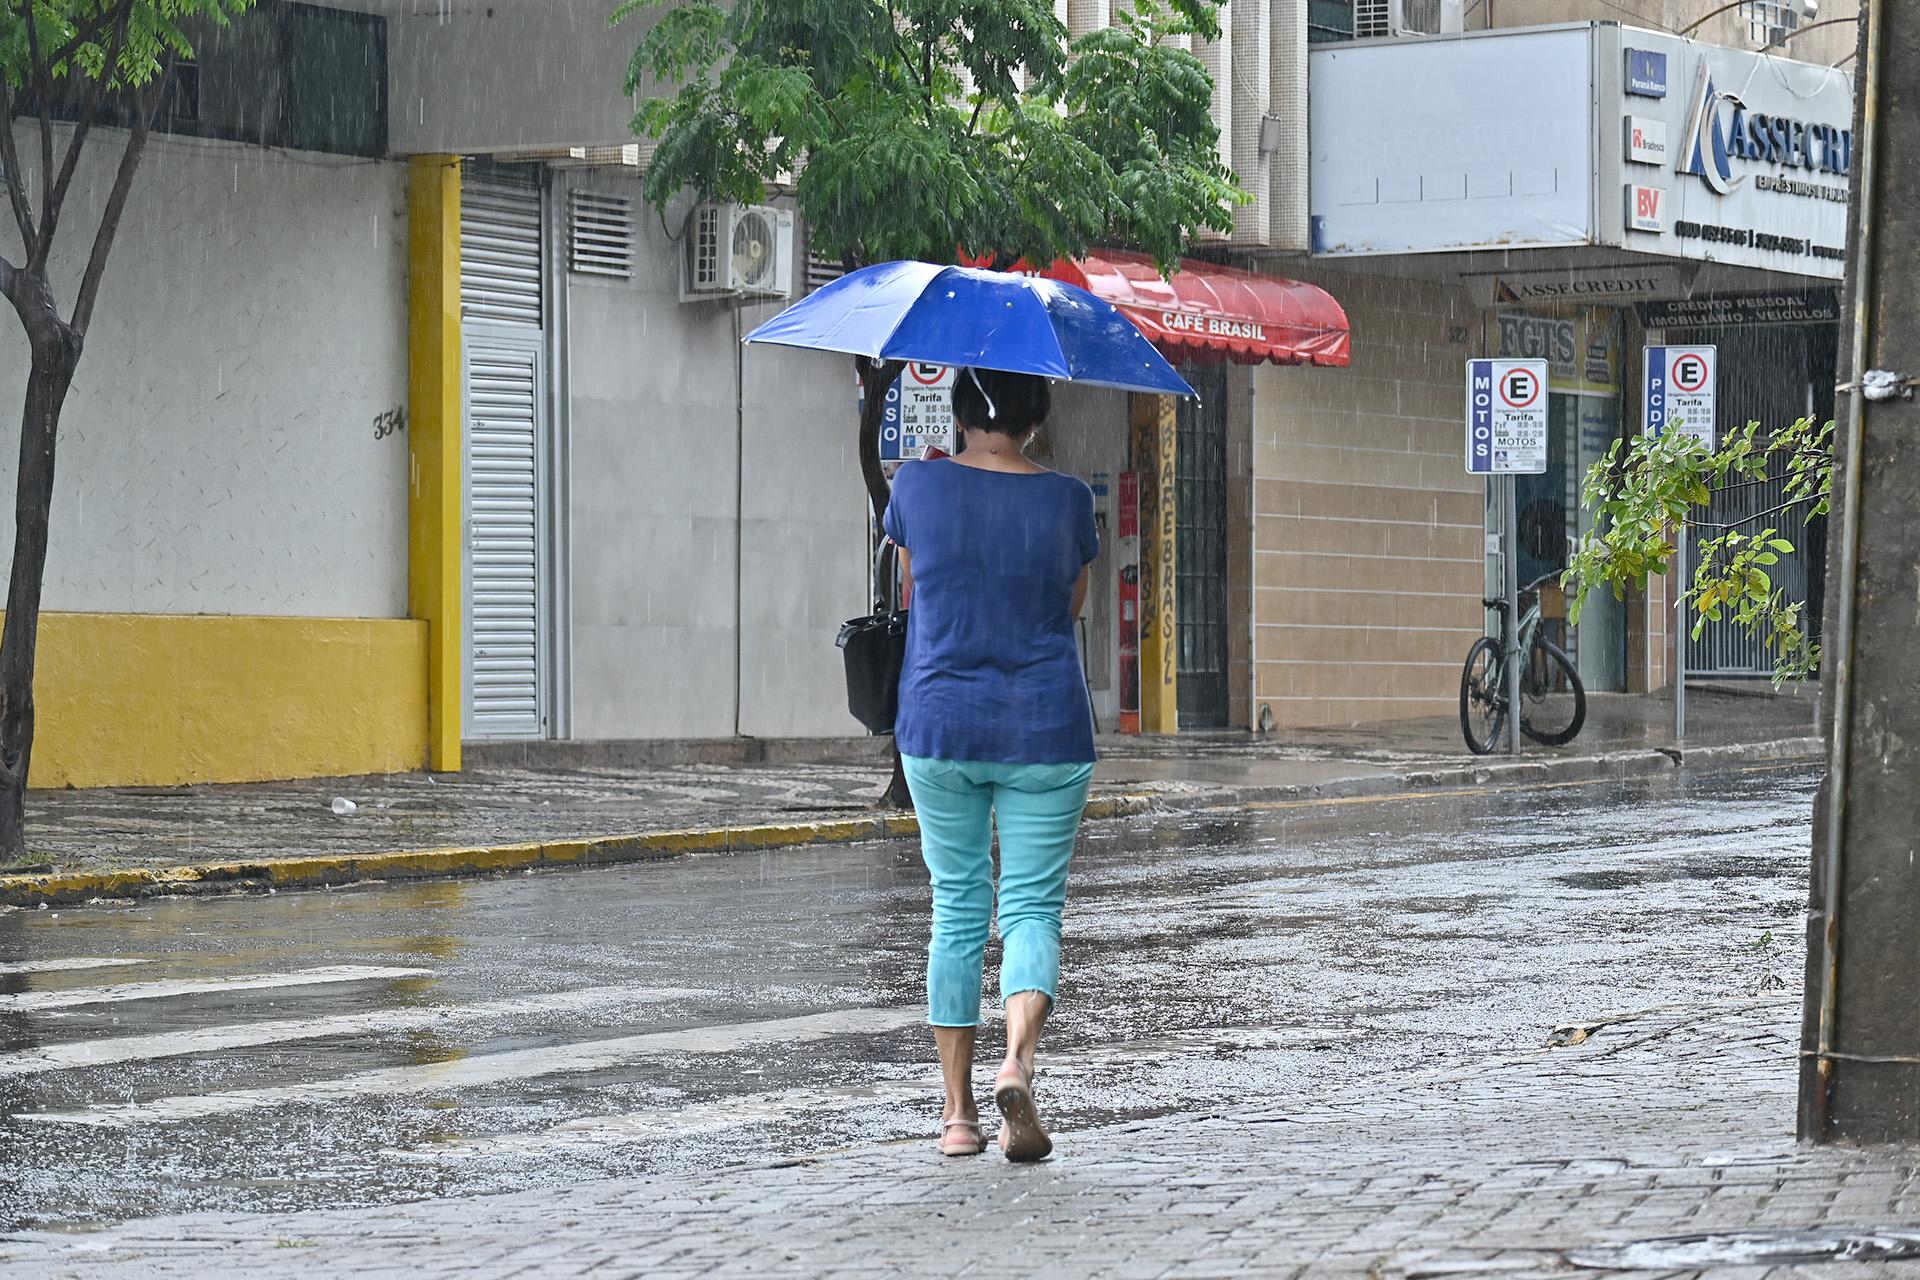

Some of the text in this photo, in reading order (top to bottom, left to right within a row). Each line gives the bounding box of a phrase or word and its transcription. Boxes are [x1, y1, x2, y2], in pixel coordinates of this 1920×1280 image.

[1632, 78, 1666, 92] Paraná Banco
[1642, 139, 1665, 152] Bradesco
[1637, 188, 1659, 218] BV
[1520, 278, 1659, 298] ASSECREDIT
[1736, 296, 1806, 309] PESSOAL
[1162, 312, 1266, 341] CAFÉ BRASIL
[1498, 316, 1577, 364] FGTS
[1681, 363, 1698, 383] E
[913, 393, 942, 402] Tarifa
[1510, 377, 1528, 399] E
[1651, 378, 1662, 422] PCD
[373, 403, 404, 440] 334
[1475, 377, 1490, 457] MOTOS
[1505, 413, 1534, 421] Tarifa
[905, 425, 948, 434] MOTOS
[1498, 438, 1536, 446] MOTOS
